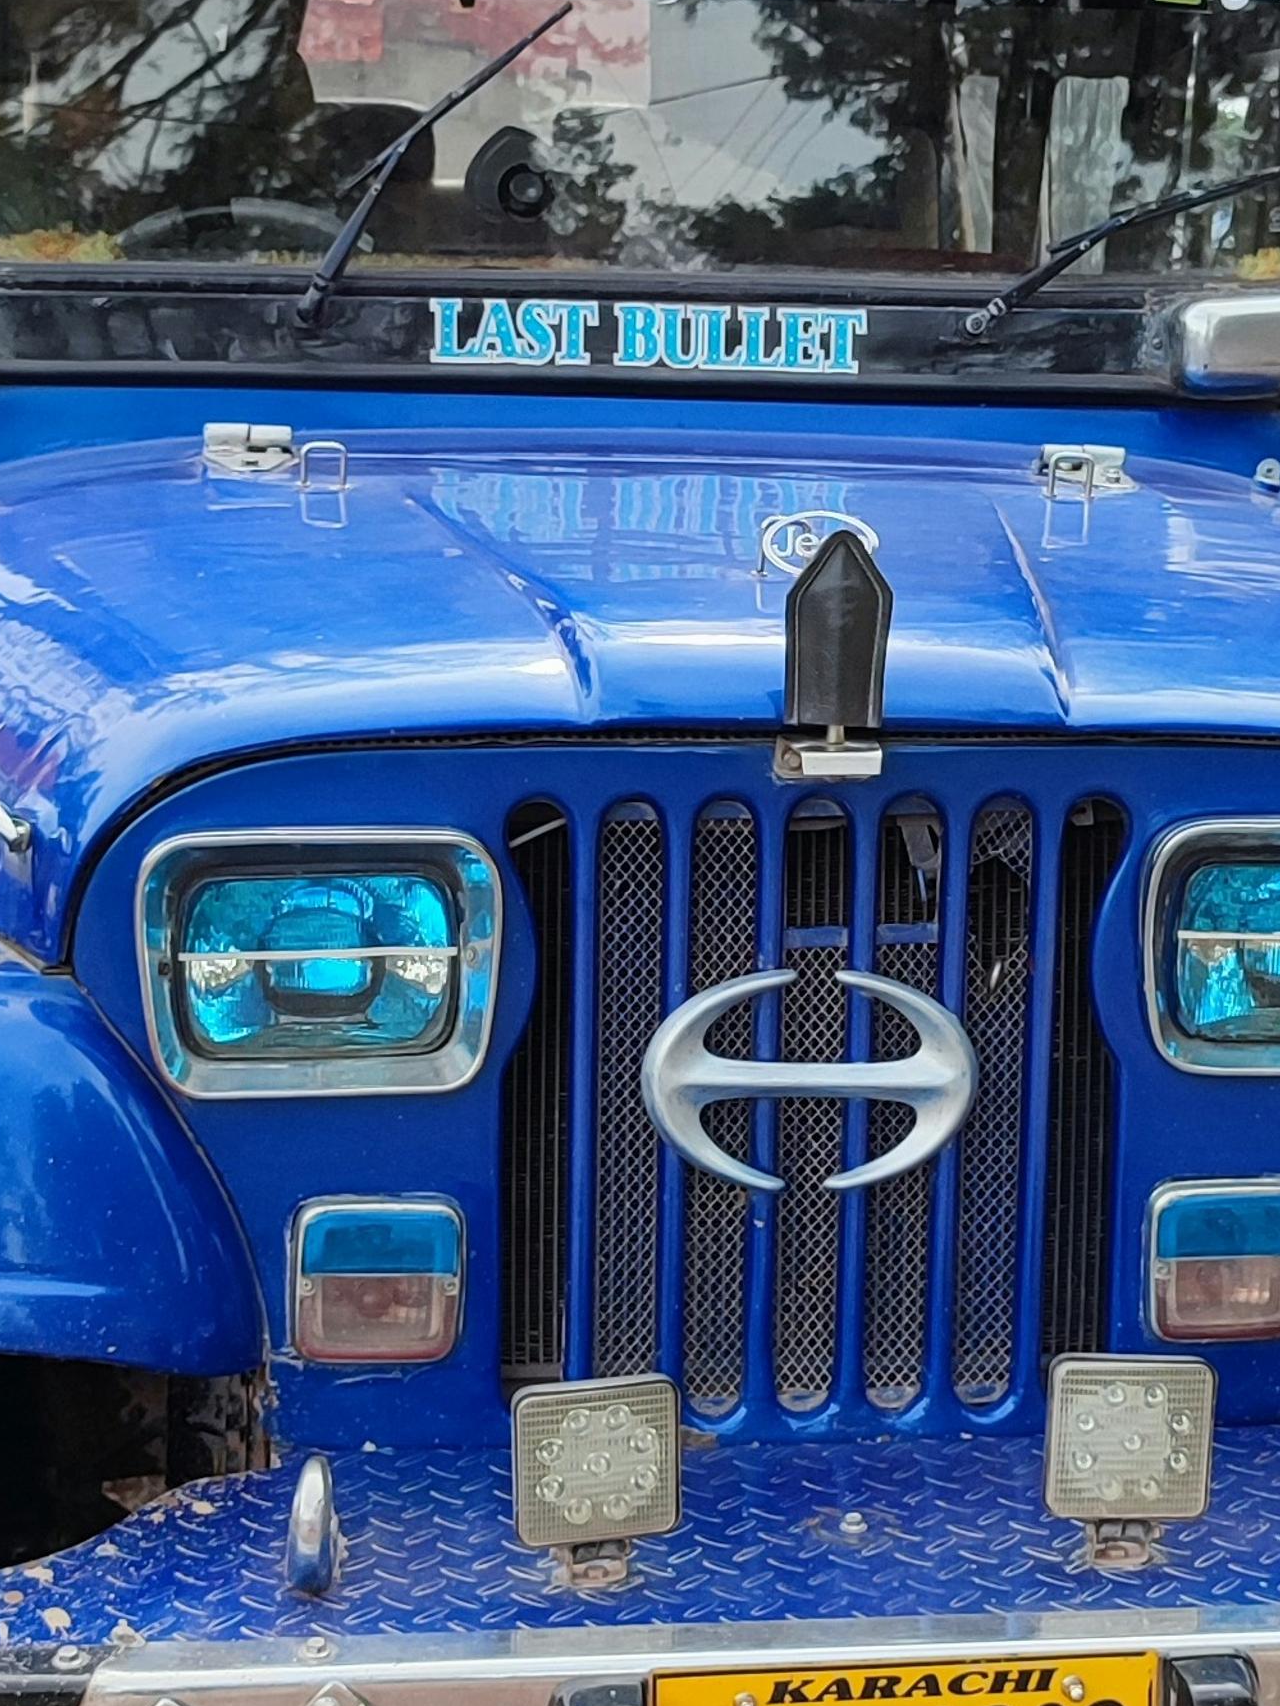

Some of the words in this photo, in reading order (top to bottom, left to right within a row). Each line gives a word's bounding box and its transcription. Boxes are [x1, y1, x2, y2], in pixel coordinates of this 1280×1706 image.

[429, 298, 599, 366] LAST
[613, 300, 868, 374] BULLET
[766, 1667, 1059, 1706] KARACHI
